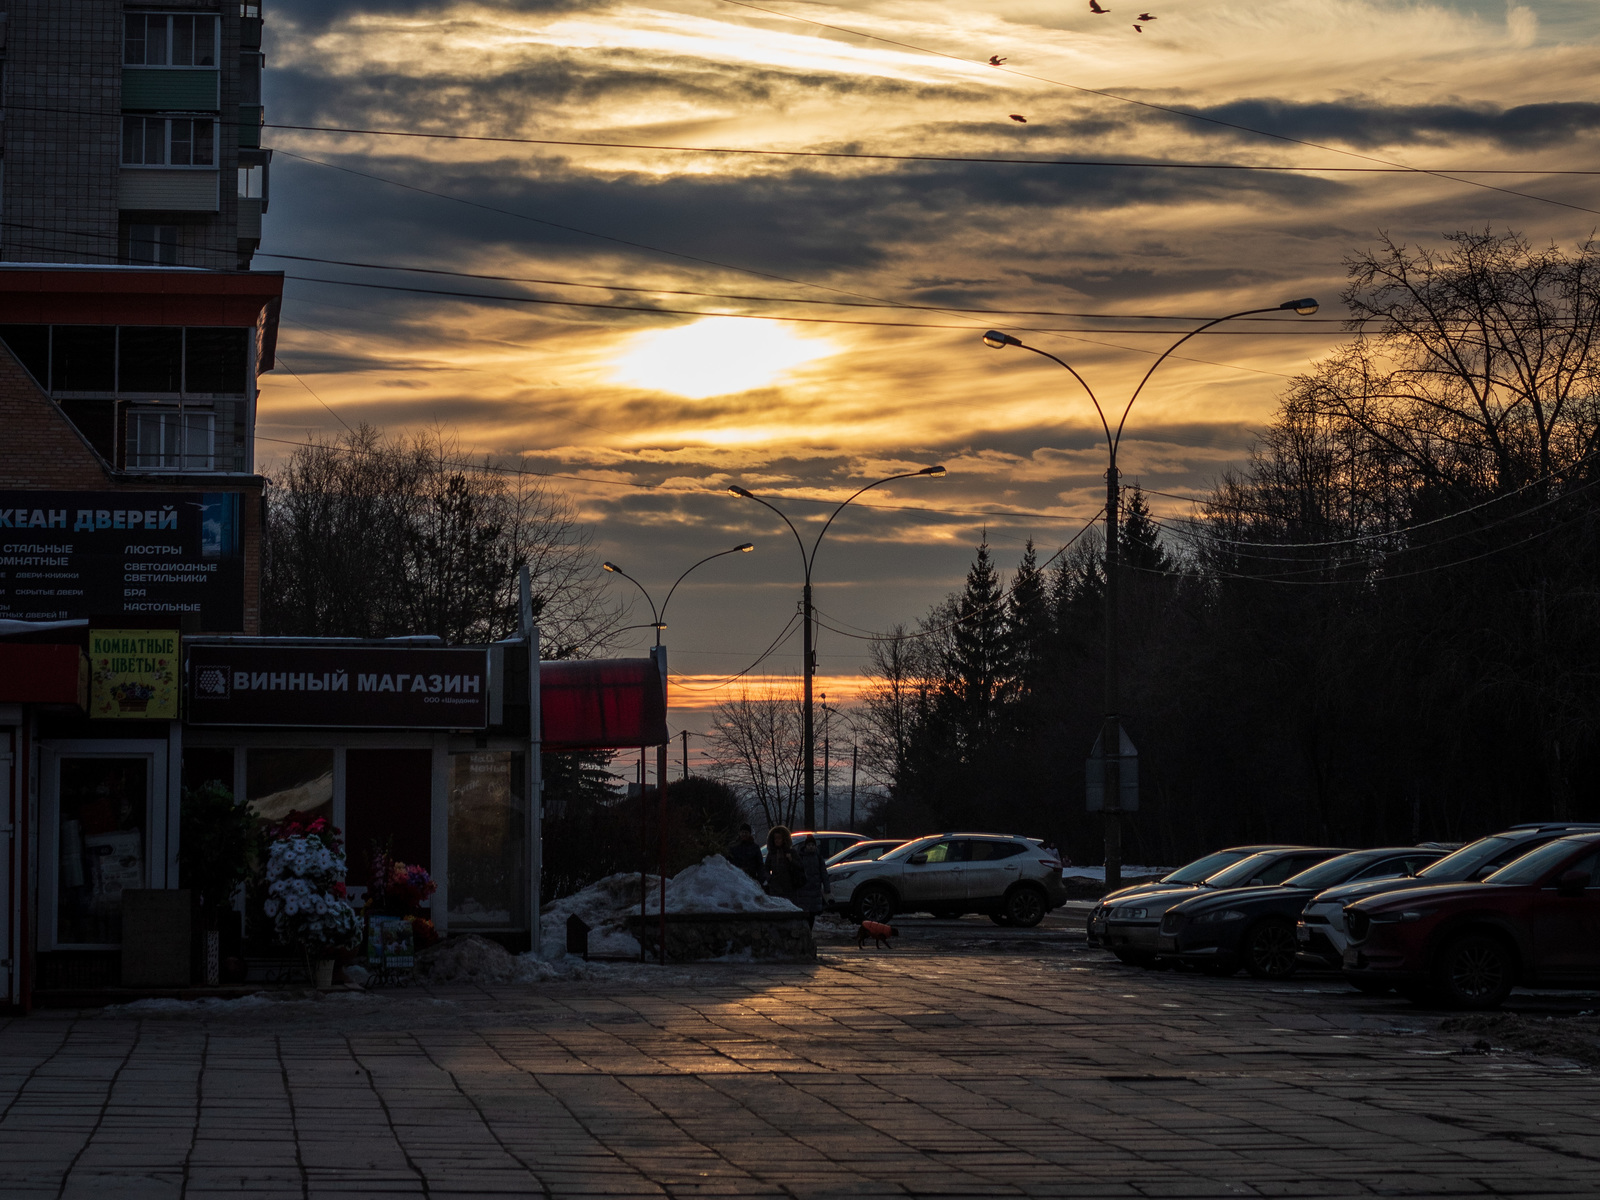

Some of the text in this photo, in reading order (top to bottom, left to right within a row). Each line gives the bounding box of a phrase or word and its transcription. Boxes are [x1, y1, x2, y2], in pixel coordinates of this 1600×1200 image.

[73, 504, 178, 533] ДВЕРЕЙ
[3, 544, 73, 554] СТАЛЬНЫЕ
[124, 545, 182, 555] ЛЮСТРЫ
[124, 562, 218, 572] СВЕТОДИОДНЫЕ
[124, 573, 207, 583] СВЕТИЛЬНИКИ
[124, 588, 147, 597] БРА
[124, 603, 201, 612] НАСТОЛЬНЫЕ
[25, 610, 57, 619] ДВЕРЕЙ
[94, 638, 174, 654] КОМНАТНЫЕ
[111, 657, 156, 674] ЦВЕТЫ
[233, 668, 480, 694] ВИННЫЙ МАГАЗИН
[423, 696, 440, 704] ООО
